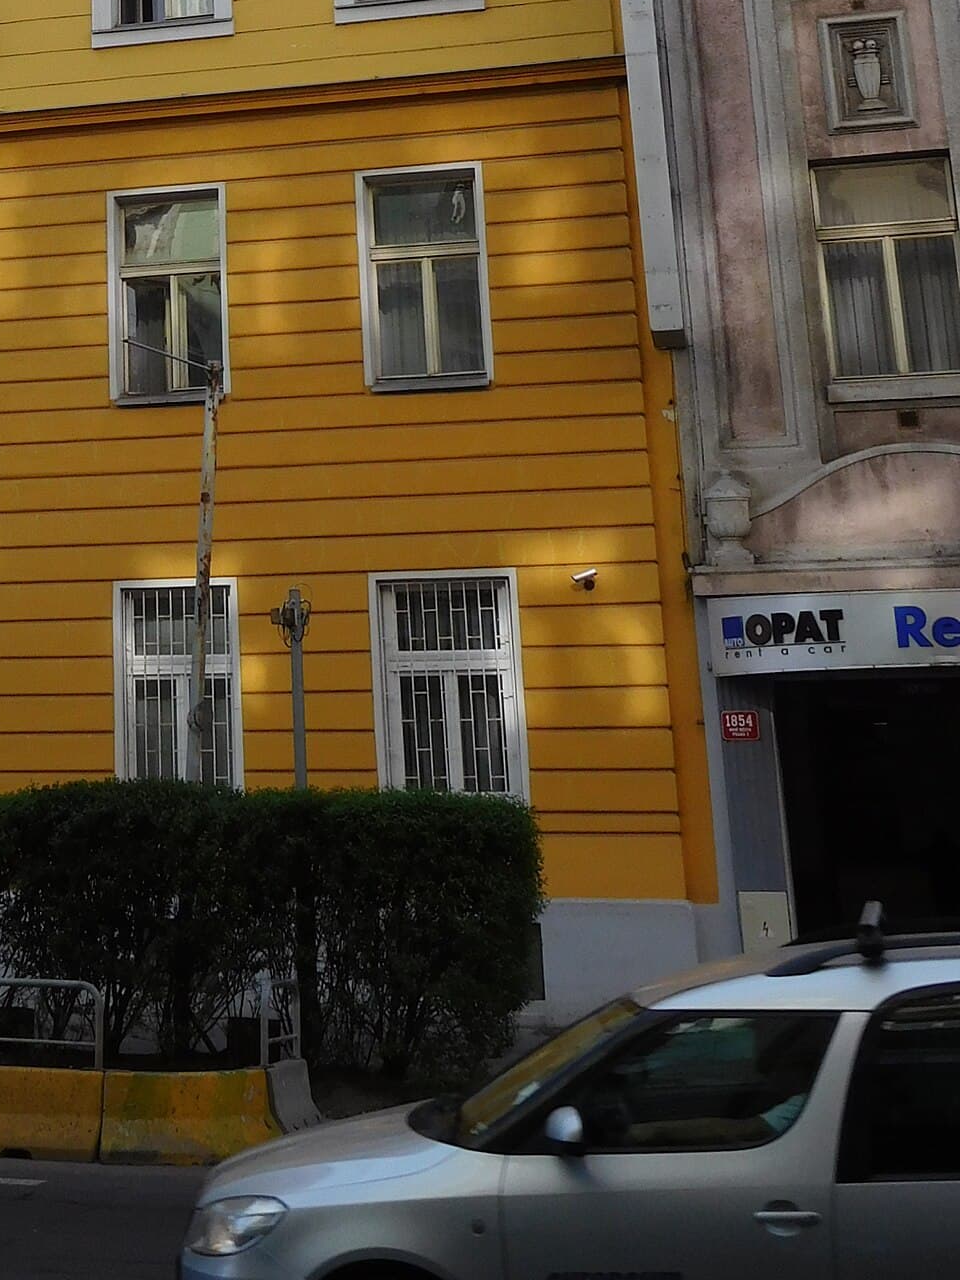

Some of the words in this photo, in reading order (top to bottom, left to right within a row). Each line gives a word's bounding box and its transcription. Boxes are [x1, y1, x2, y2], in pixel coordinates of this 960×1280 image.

[745, 609, 844, 645] OPAT
[893, 605, 960, 648] Re
[724, 638, 744, 647] AUTO
[725, 647, 763, 659] rent
[781, 648, 789, 656] a
[807, 644, 846, 655] car
[725, 714, 753, 727] 1854
